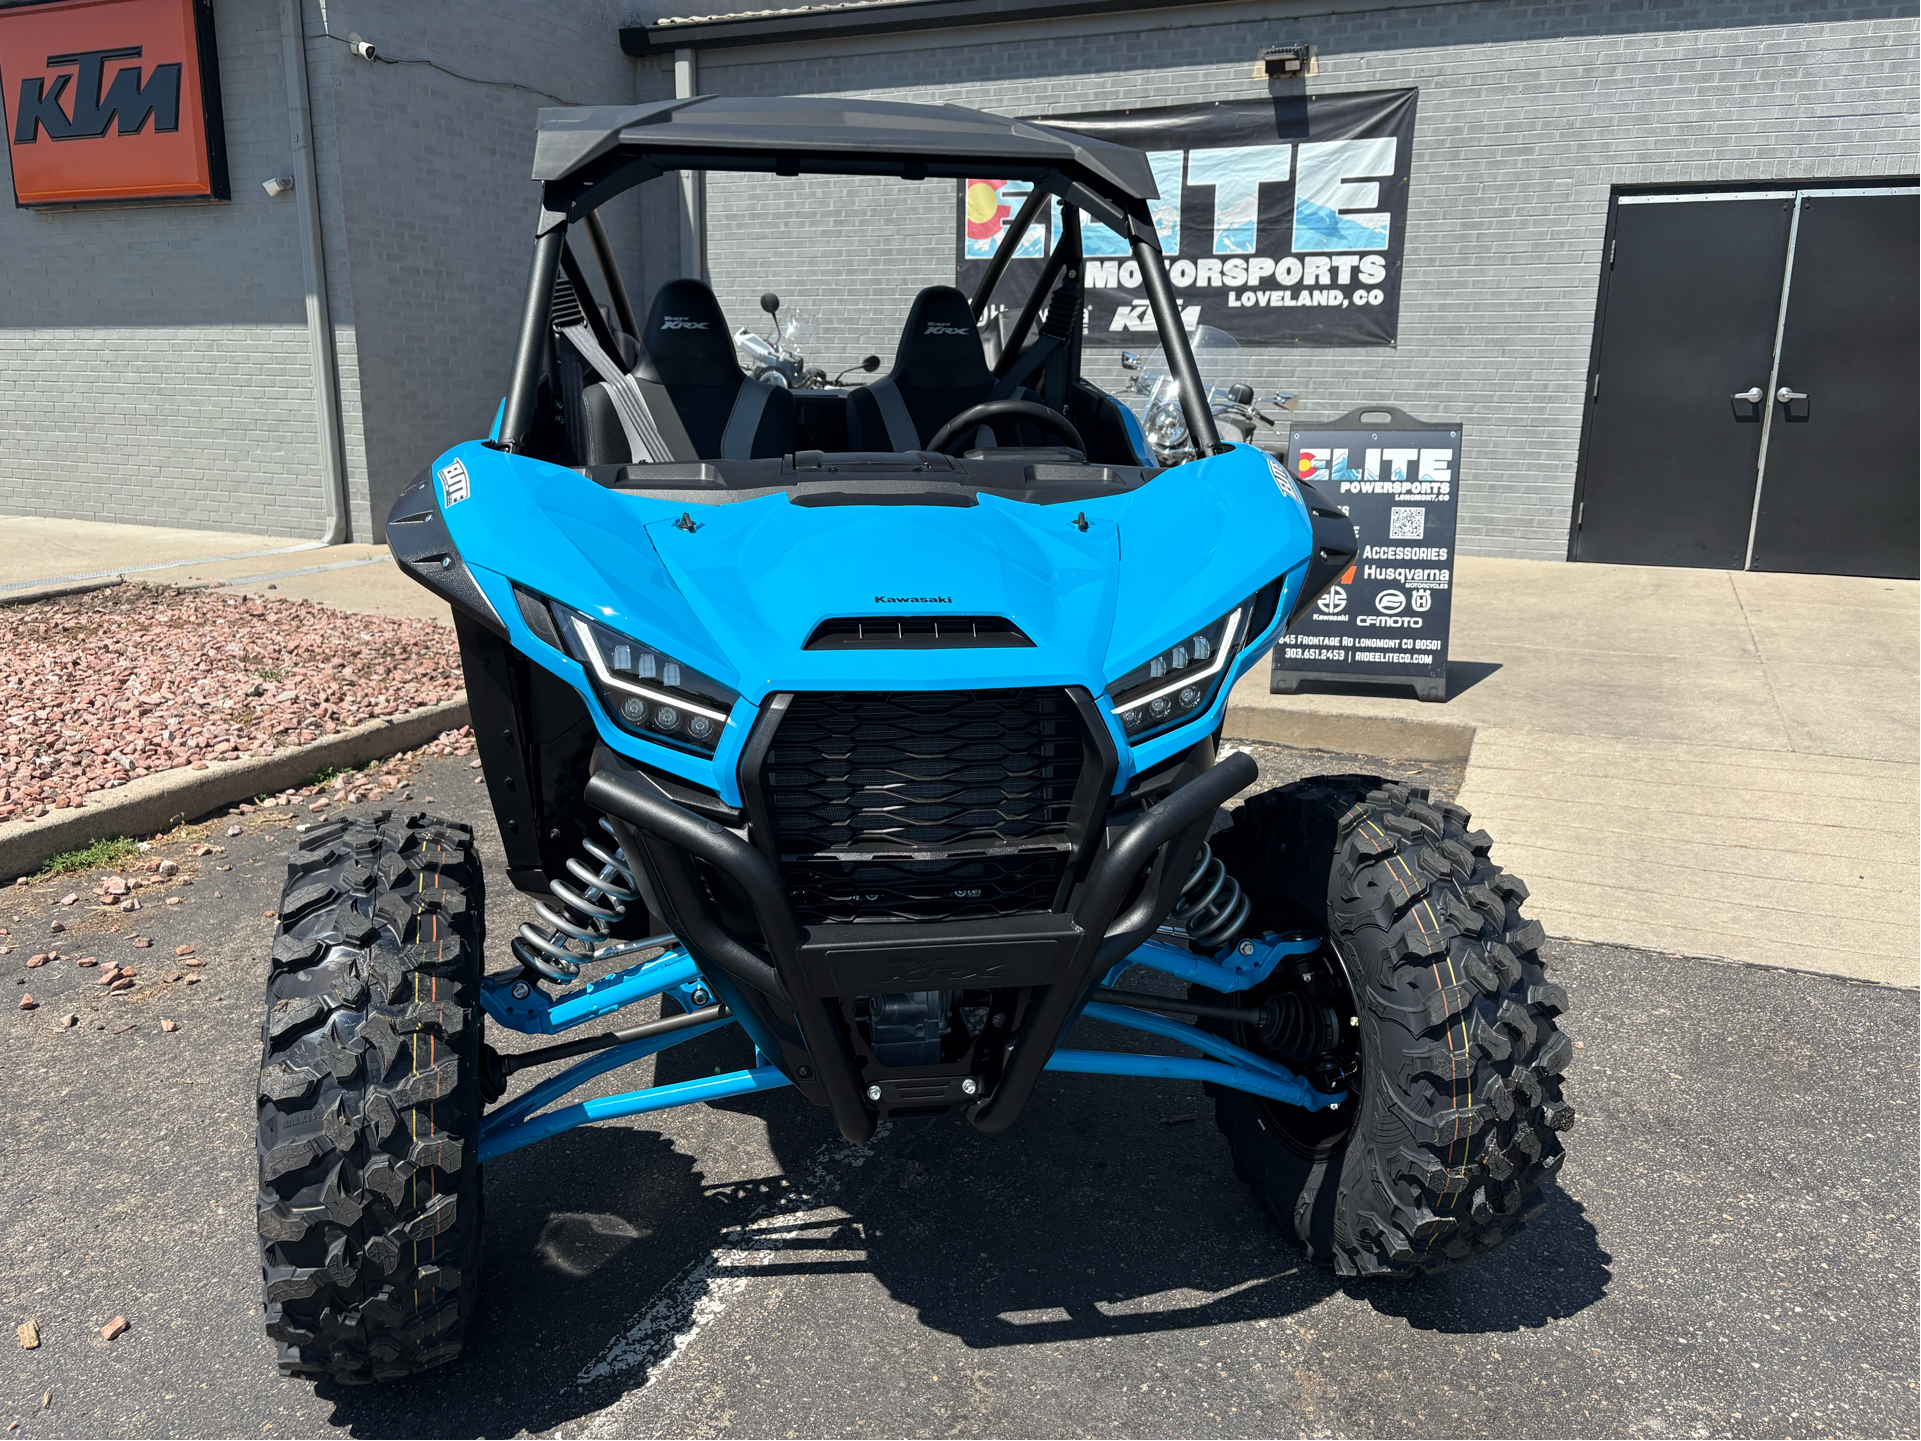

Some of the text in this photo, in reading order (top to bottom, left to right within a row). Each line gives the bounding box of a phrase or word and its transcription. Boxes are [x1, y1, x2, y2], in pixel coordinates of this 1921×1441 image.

[14, 45, 182, 145] KTM
[1084, 255, 1386, 288] MOORSPORTS
[1228, 289, 1384, 309] LOVELAND, CO
[660, 321, 710, 330] KRX
[923, 326, 970, 335] KRX
[1298, 448, 1453, 481] ELITE
[1340, 481, 1450, 494] POWERSPORTS
[1363, 545, 1448, 561] ACCESSORIES
[1364, 565, 1450, 584] Husqvarna
[875, 596, 953, 604] Kawasaki
[1313, 613, 1349, 622] Kawasaki
[1356, 615, 1423, 628] CFMOTO
[1297, 635, 1340, 646] FRONTAGE
[1342, 636, 1354, 647] RD
[1355, 637, 1400, 649] LONGMONT
[1401, 638, 1413, 649] CO
[1415, 639, 1442, 651] 80501
[1284, 648, 1433, 665] 303.651.2453 RIDEELITECO.COM
